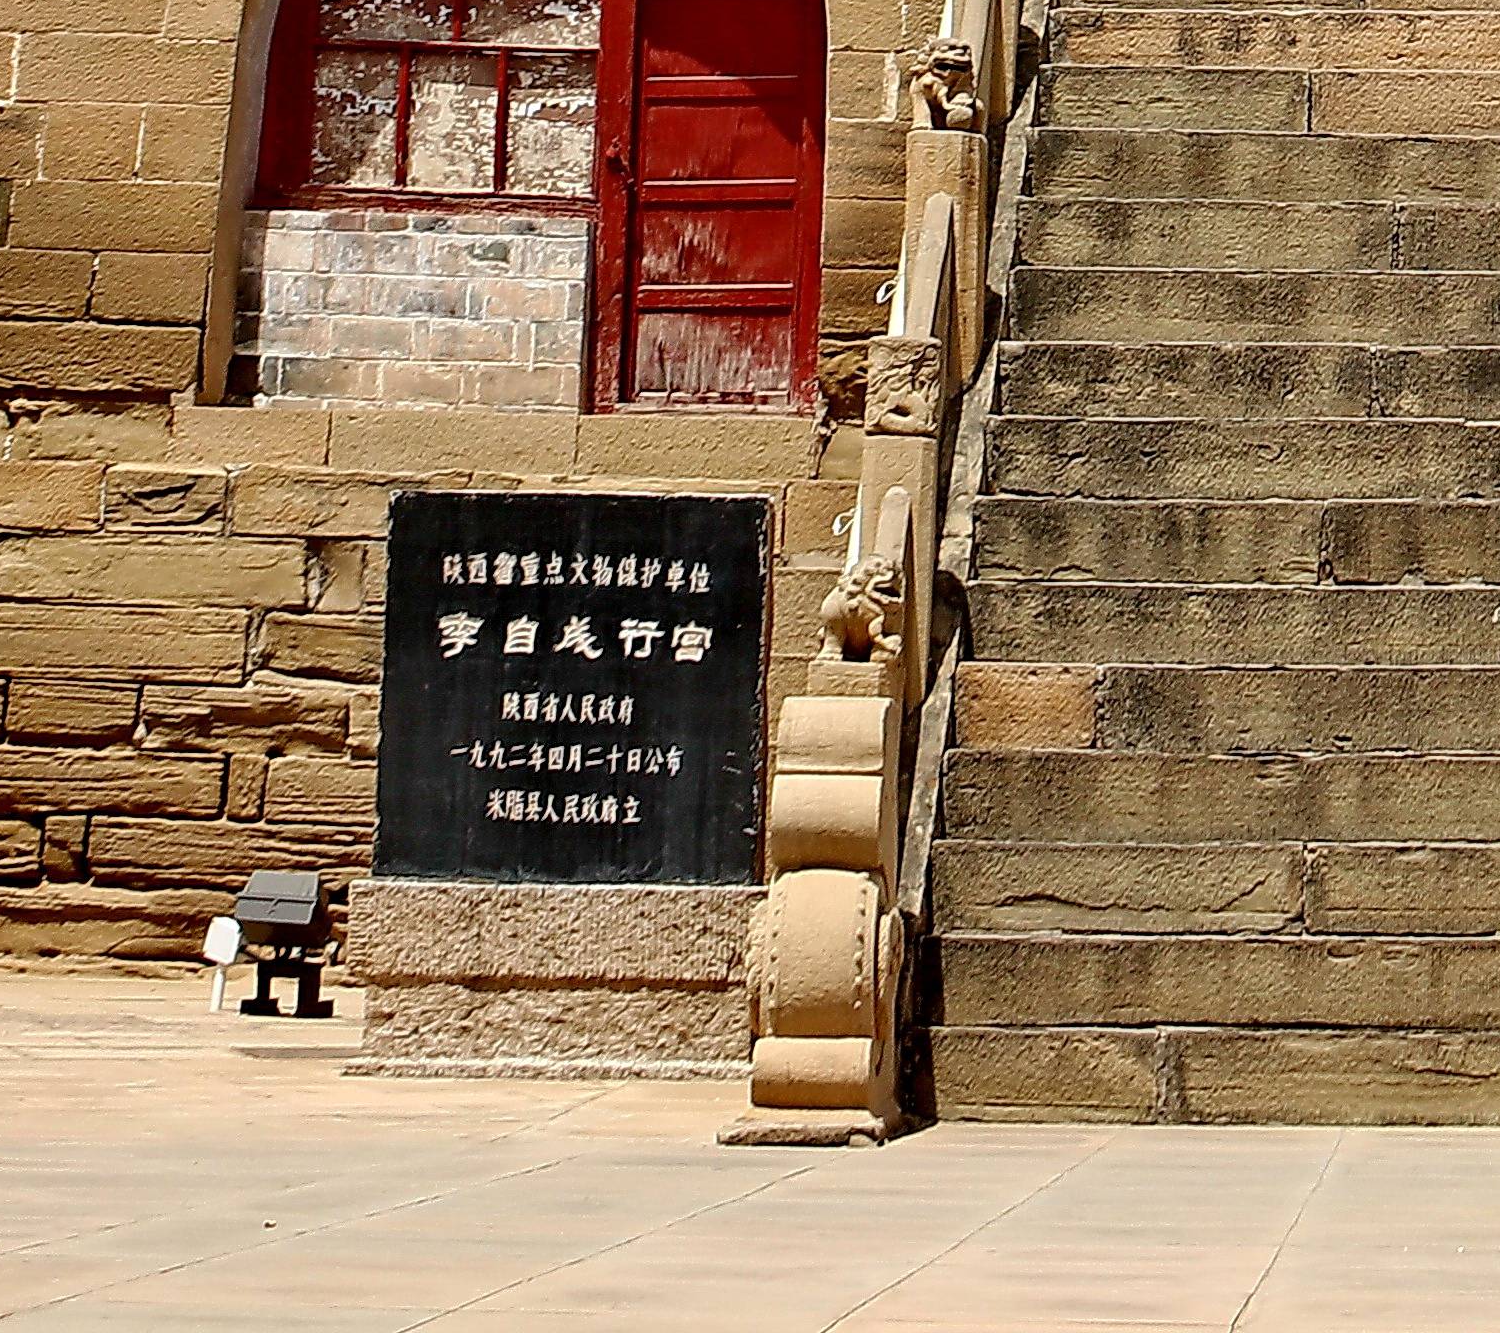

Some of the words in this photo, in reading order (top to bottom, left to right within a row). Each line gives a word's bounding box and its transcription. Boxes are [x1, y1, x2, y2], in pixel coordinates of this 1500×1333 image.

[442, 550, 711, 593] 陕西省重点文物保护单位
[438, 611, 713, 662] 李自成行宫
[501, 690, 635, 725] 陕西省人民政府
[449, 739, 684, 776] 一九九二年四月二十日公布
[485, 788, 642, 824] 米脂县人民政府立
